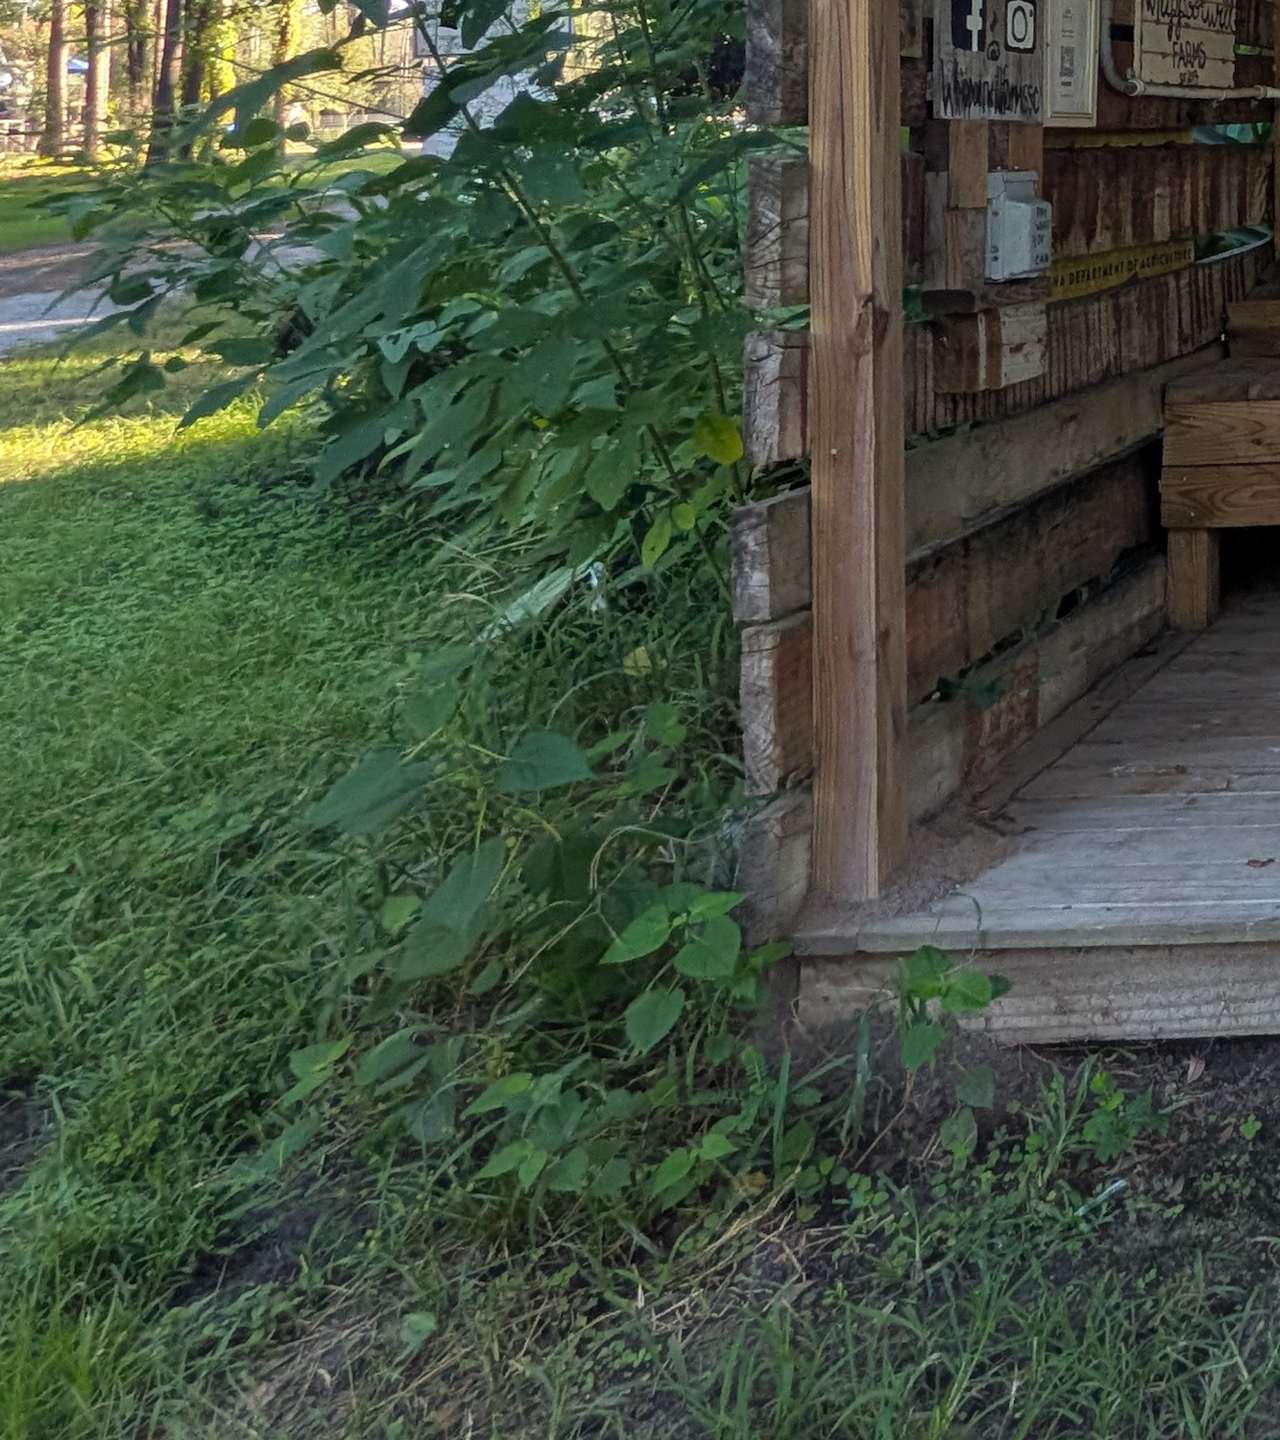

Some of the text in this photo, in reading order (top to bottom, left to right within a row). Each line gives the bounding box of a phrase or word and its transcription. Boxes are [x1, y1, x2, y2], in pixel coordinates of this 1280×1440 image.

[1172, 40, 1206, 69] FARMS
[1069, 261, 1124, 286] DEPARTMENT
[1127, 258, 1138, 272] OF
[1140, 247, 1192, 270] AGRICULTURE
